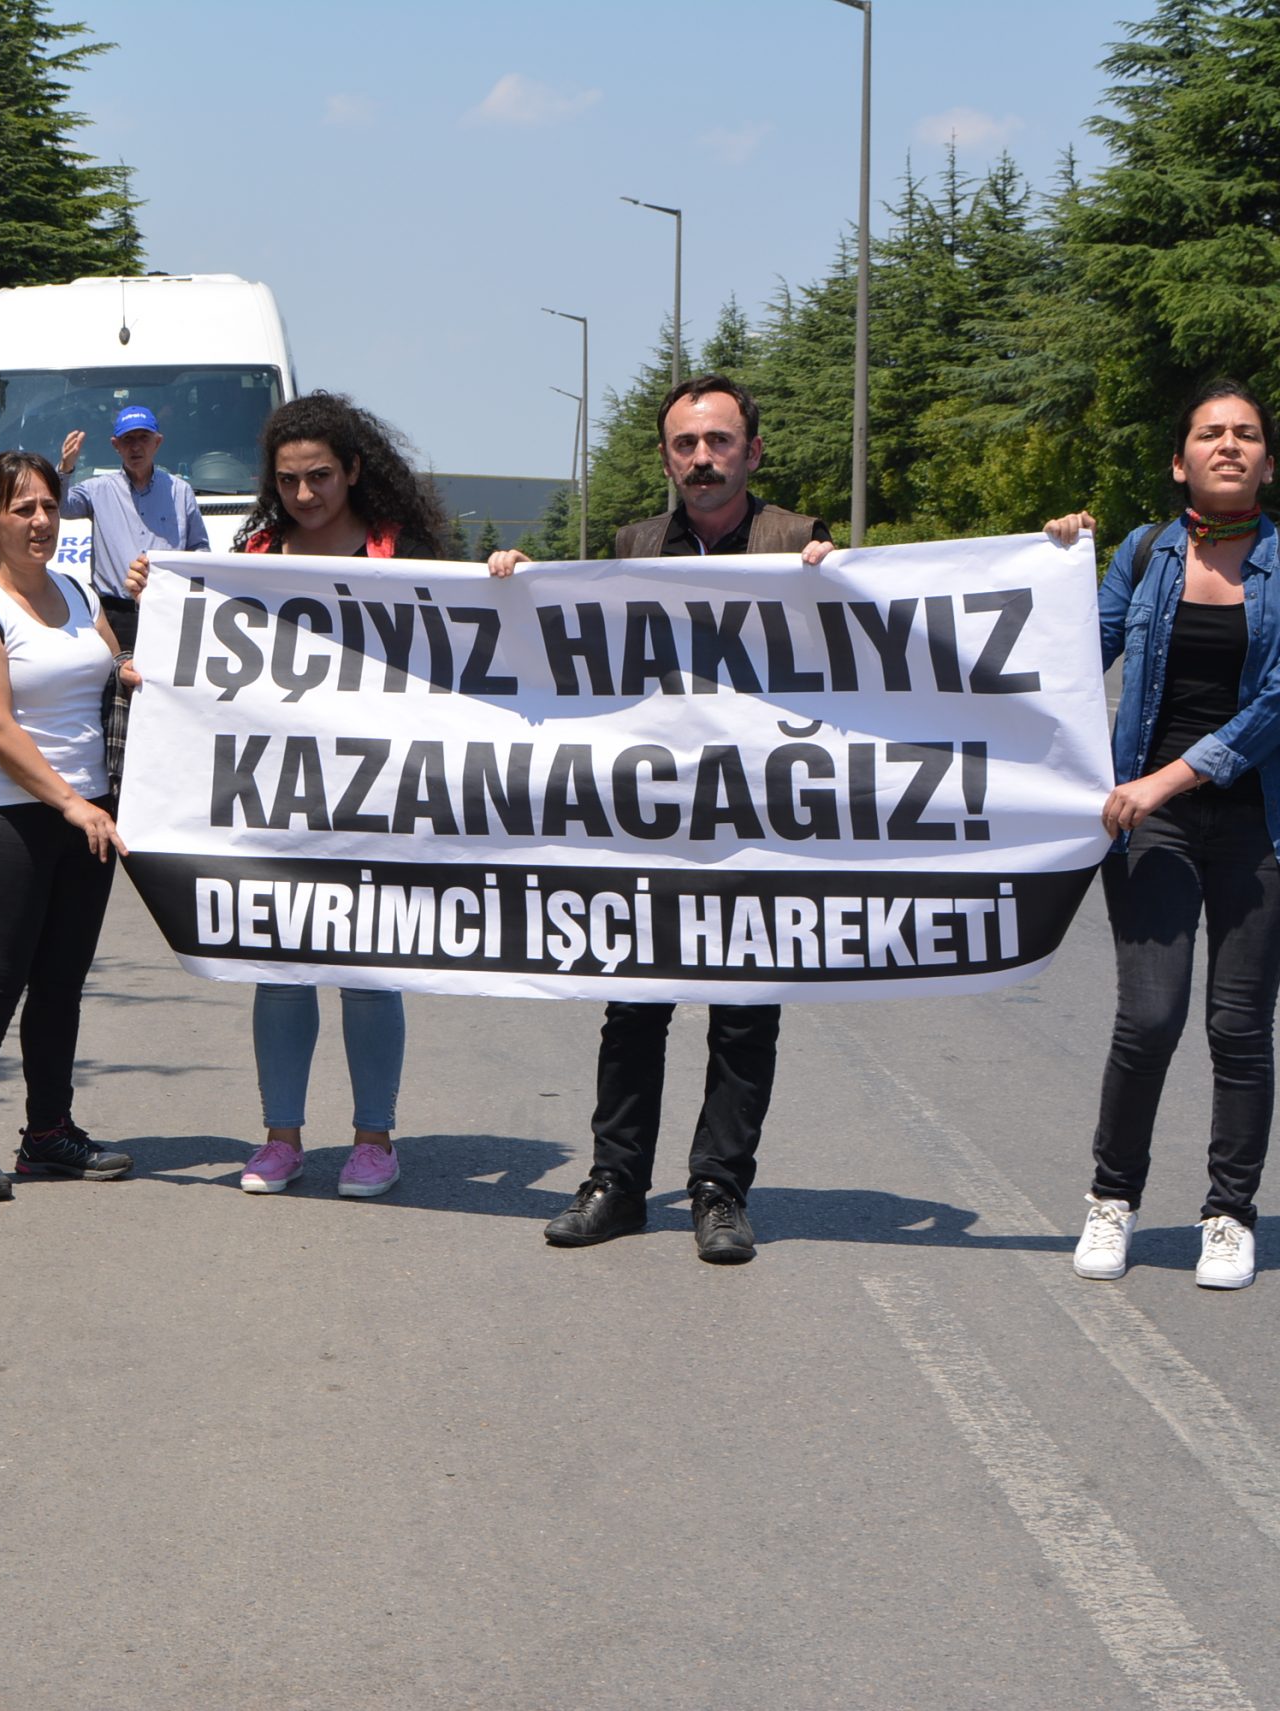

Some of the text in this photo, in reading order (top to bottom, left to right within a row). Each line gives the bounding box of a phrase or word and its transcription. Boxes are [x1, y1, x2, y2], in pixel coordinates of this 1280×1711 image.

[173, 576, 1042, 703] İŞÇİYİZ HAKLIYIZ
[210, 719, 991, 841] KAZANACAĞIZ!
[195, 868, 1020, 974] DEVRİMCİ İŞÇİ HAREKETİ
